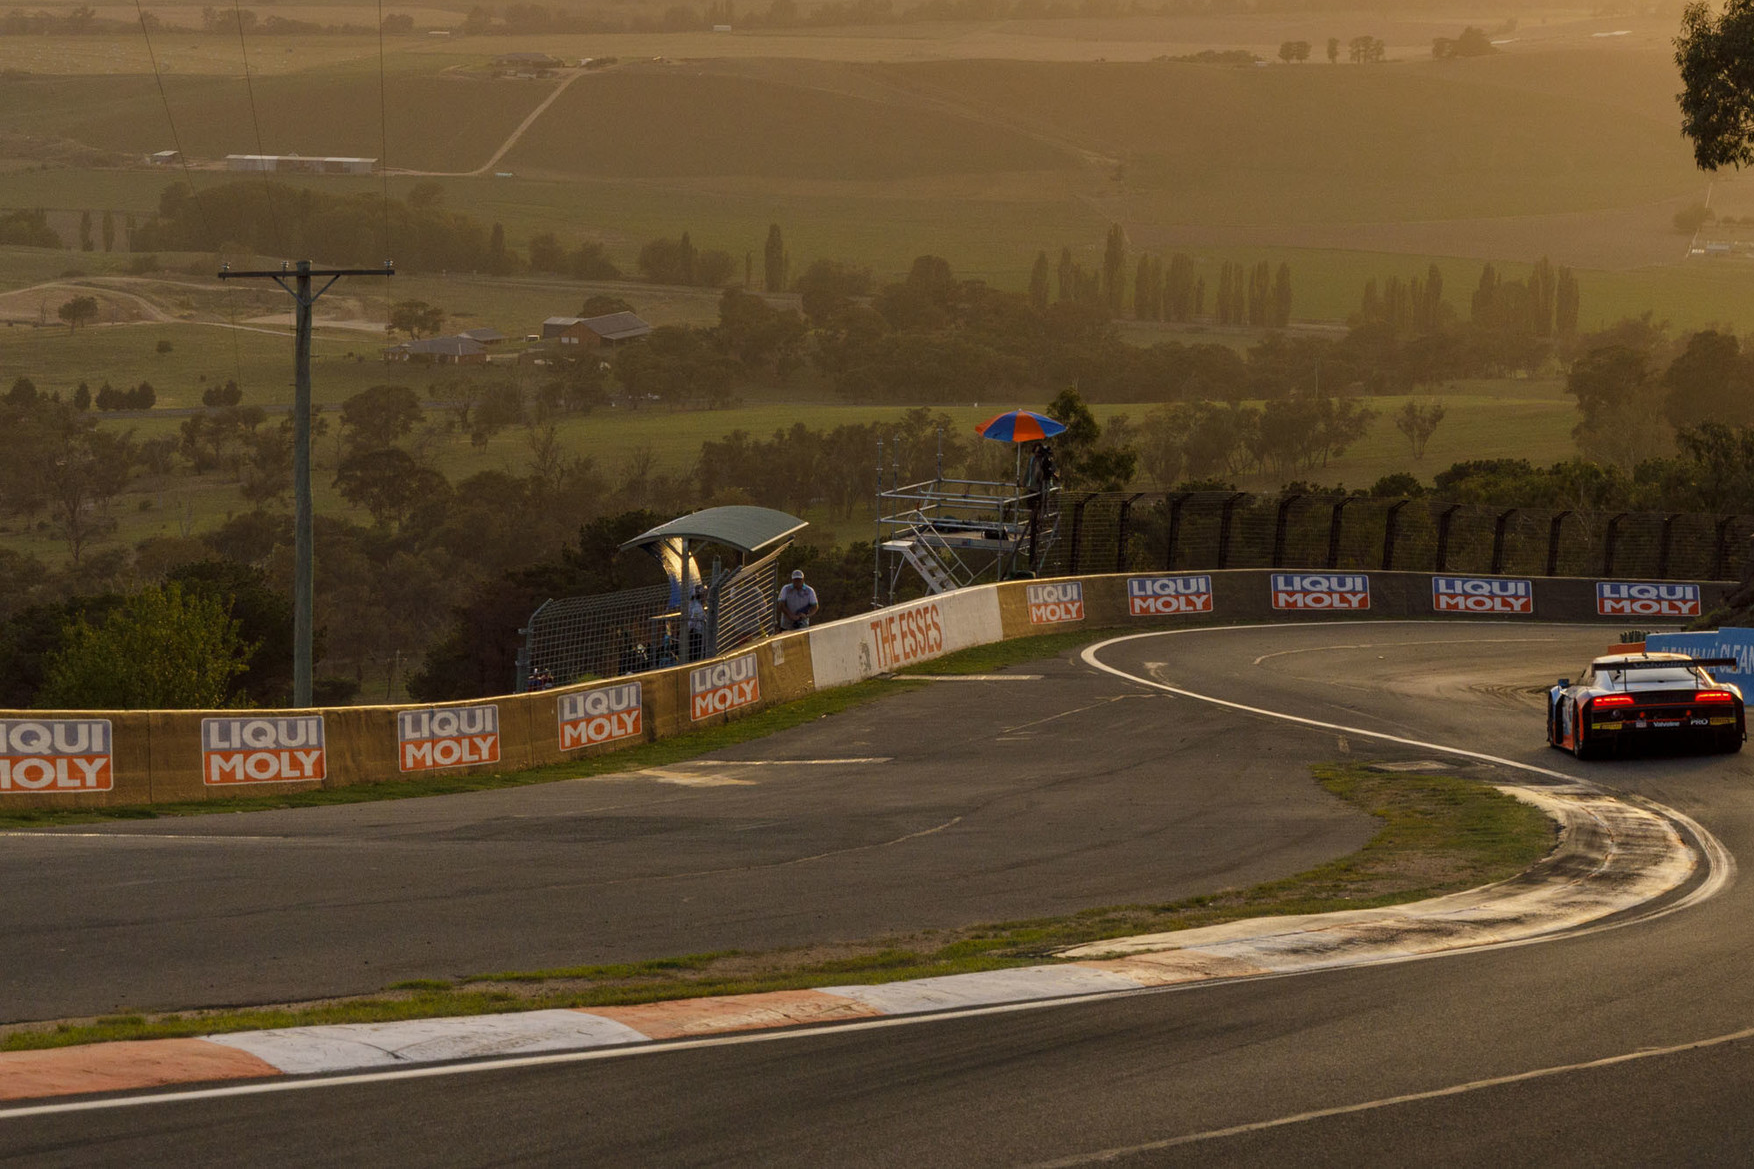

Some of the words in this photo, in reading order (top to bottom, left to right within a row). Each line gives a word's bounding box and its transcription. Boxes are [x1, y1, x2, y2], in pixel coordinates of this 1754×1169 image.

[1030, 583, 1078, 604] LIQUI
[1128, 577, 1206, 596] LIQUI
[1276, 576, 1364, 592] LIQUI
[1439, 580, 1526, 596] LIQUI
[1602, 584, 1694, 600] LIQUI
[1032, 601, 1080, 623] MOLY
[1133, 595, 1210, 614] MOLY
[1278, 592, 1367, 609] MOLY
[1440, 595, 1528, 612] MOLY
[1603, 599, 1696, 615] MOLY
[870, 616, 900, 669] THE
[898, 603, 943, 660] ESSES
[695, 658, 755, 692] LIQUI
[563, 686, 639, 721] LIQUI
[695, 679, 756, 713] MOLY
[209, 720, 319, 749] LIQUI
[404, 706, 496, 739] LIQUI
[564, 710, 639, 748] MOLY
[0, 722, 104, 755] IQUI
[405, 736, 497, 768] MOLY
[210, 750, 321, 781] MOLY
